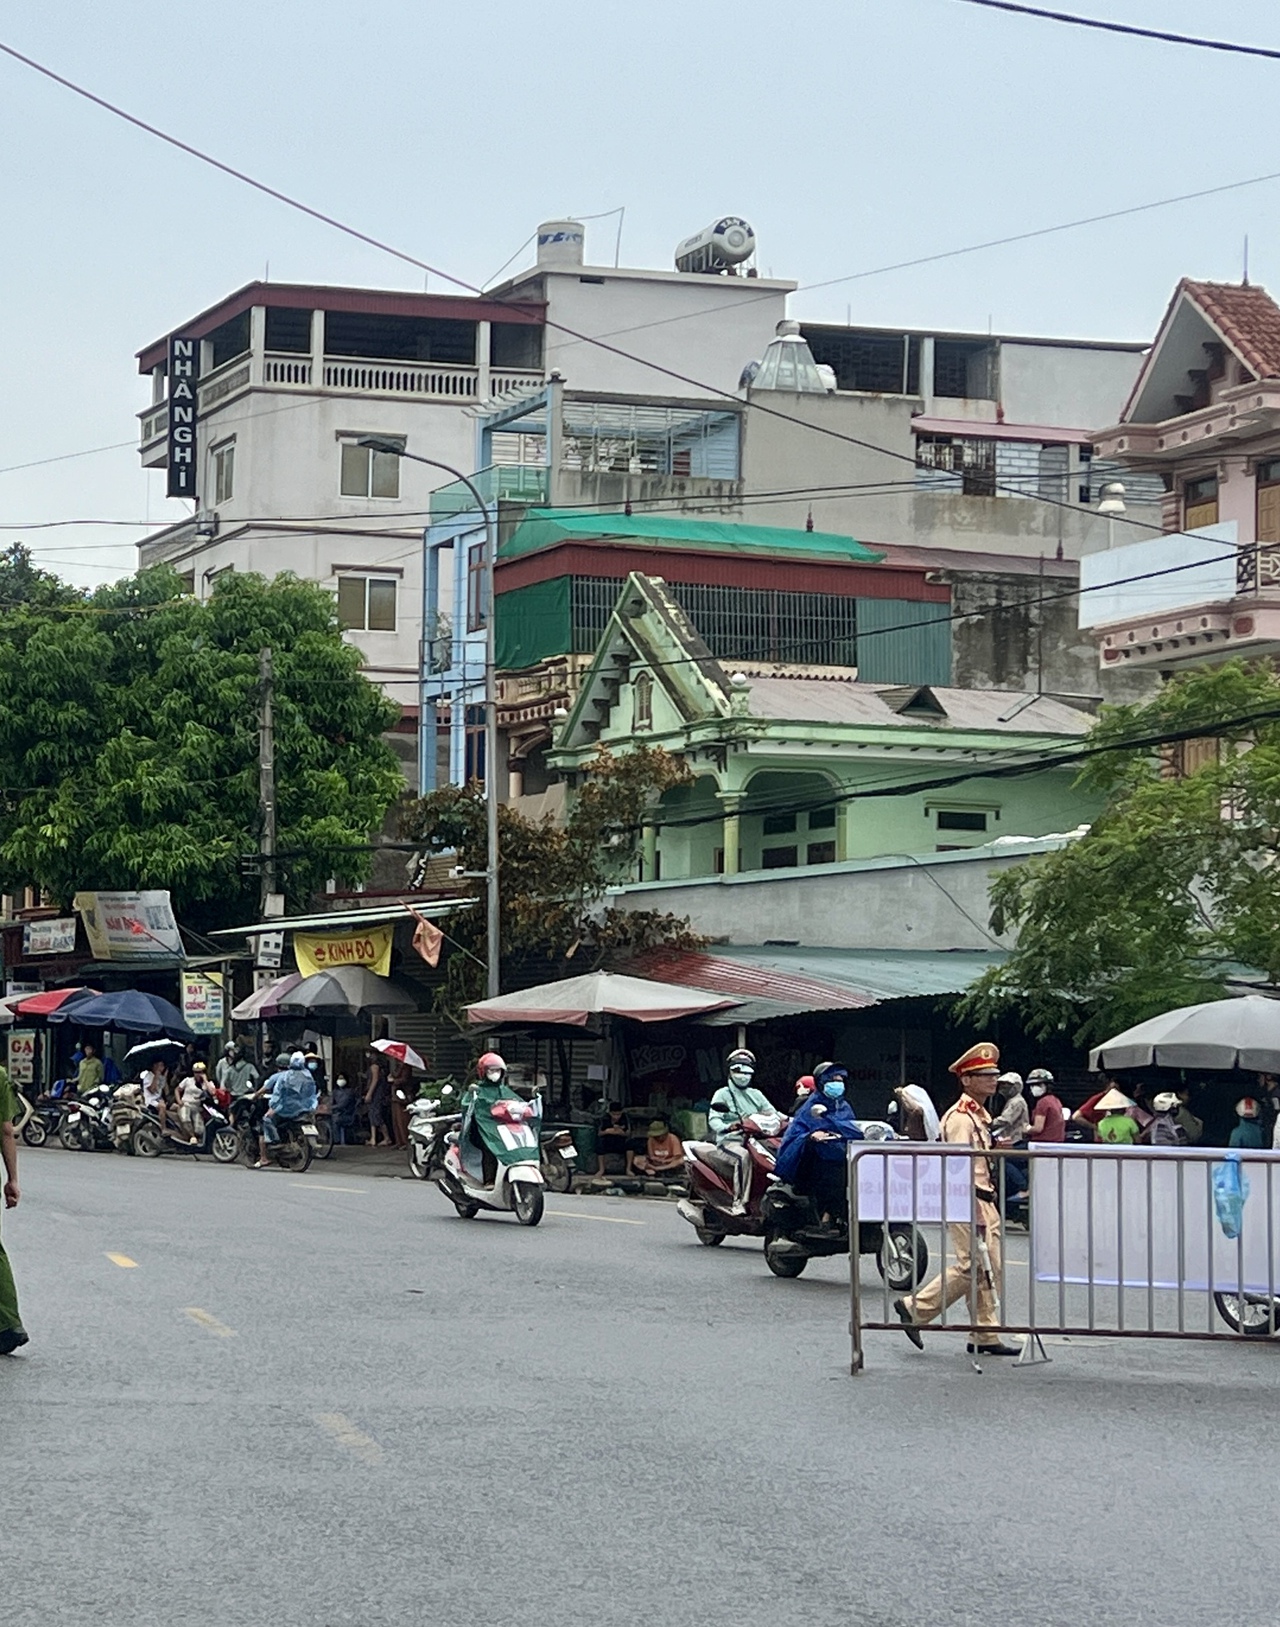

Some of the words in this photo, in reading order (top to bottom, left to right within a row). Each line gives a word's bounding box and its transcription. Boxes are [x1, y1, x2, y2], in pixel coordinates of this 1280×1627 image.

[173, 340, 193, 399] NHÀ
[173, 406, 193, 488] NGHỈ
[327, 941, 355, 962] KINH
[356, 935, 375, 960] ĐÔ
